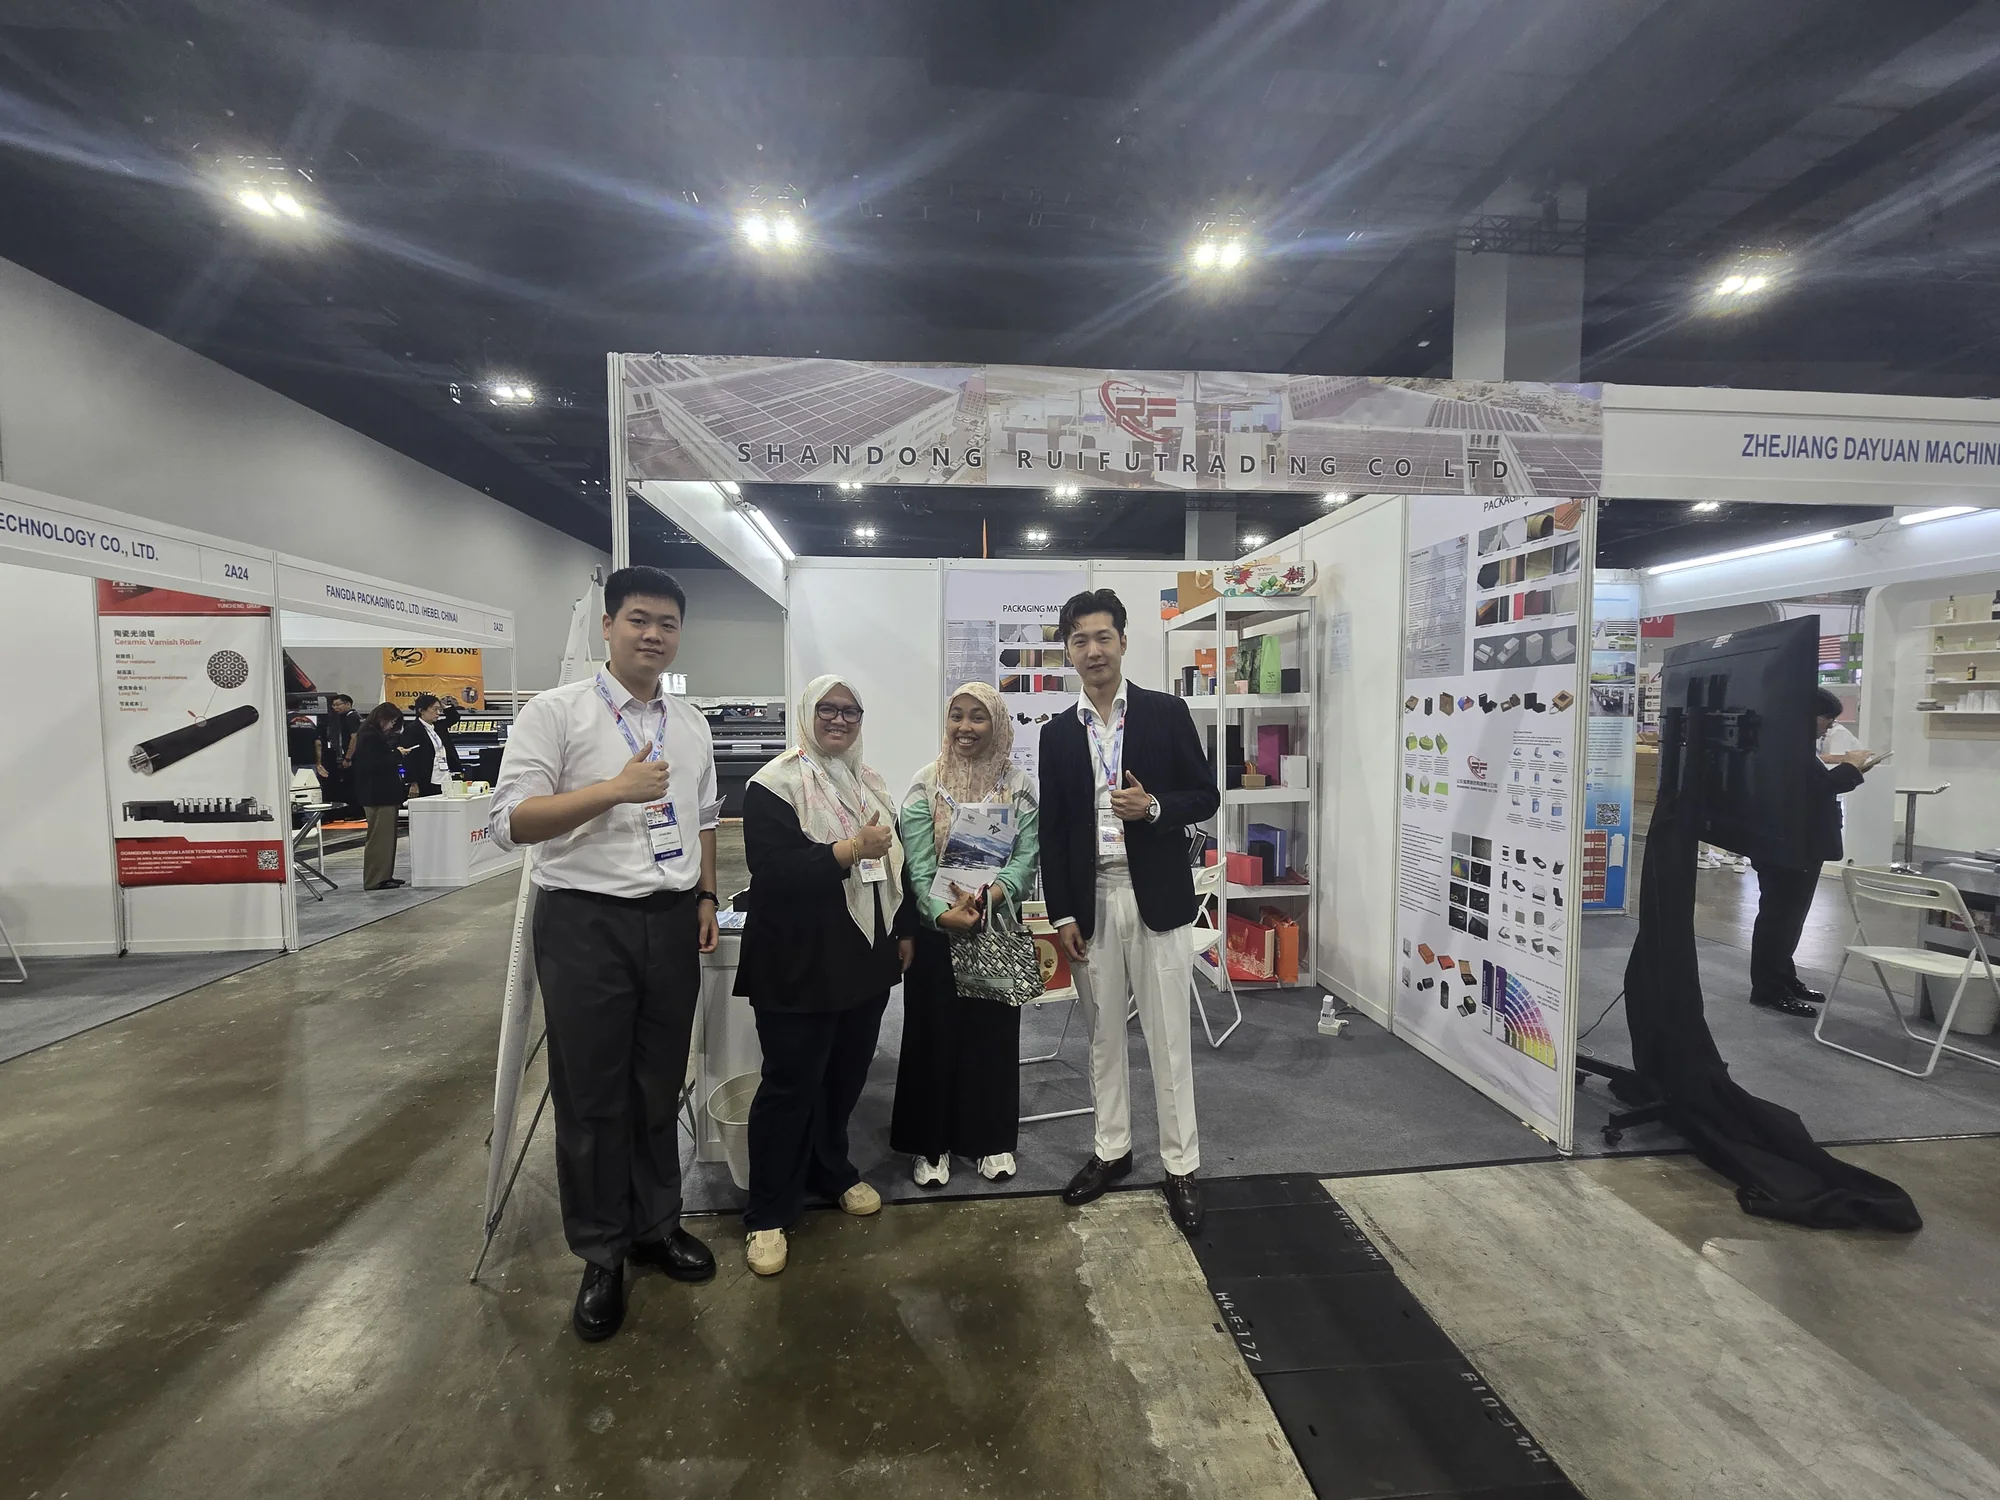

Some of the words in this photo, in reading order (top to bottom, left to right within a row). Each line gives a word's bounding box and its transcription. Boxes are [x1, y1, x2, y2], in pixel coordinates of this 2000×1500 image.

[1742, 433, 1838, 460] ZHEJIANG
[1843, 437, 1920, 463] DAYUAN
[736, 442, 982, 469] SHANDONG
[1368, 457, 1412, 478] CO
[1444, 458, 1509, 480] LTD
[1483, 496, 1524, 512] PACKAG
[100, 534, 129, 557] CO.,
[132, 541, 159, 561] LTD.
[224, 563, 249, 581] 2A24
[326, 584, 356, 602] FANGDA
[357, 591, 395, 610] PACKAGING
[408, 603, 421, 615] LTD.
[441, 609, 458, 623] CHINA)
[1002, 605, 1045, 613] PACKAGING
[493, 622, 504, 632] 2A22
[435, 647, 478, 655] DELONE
